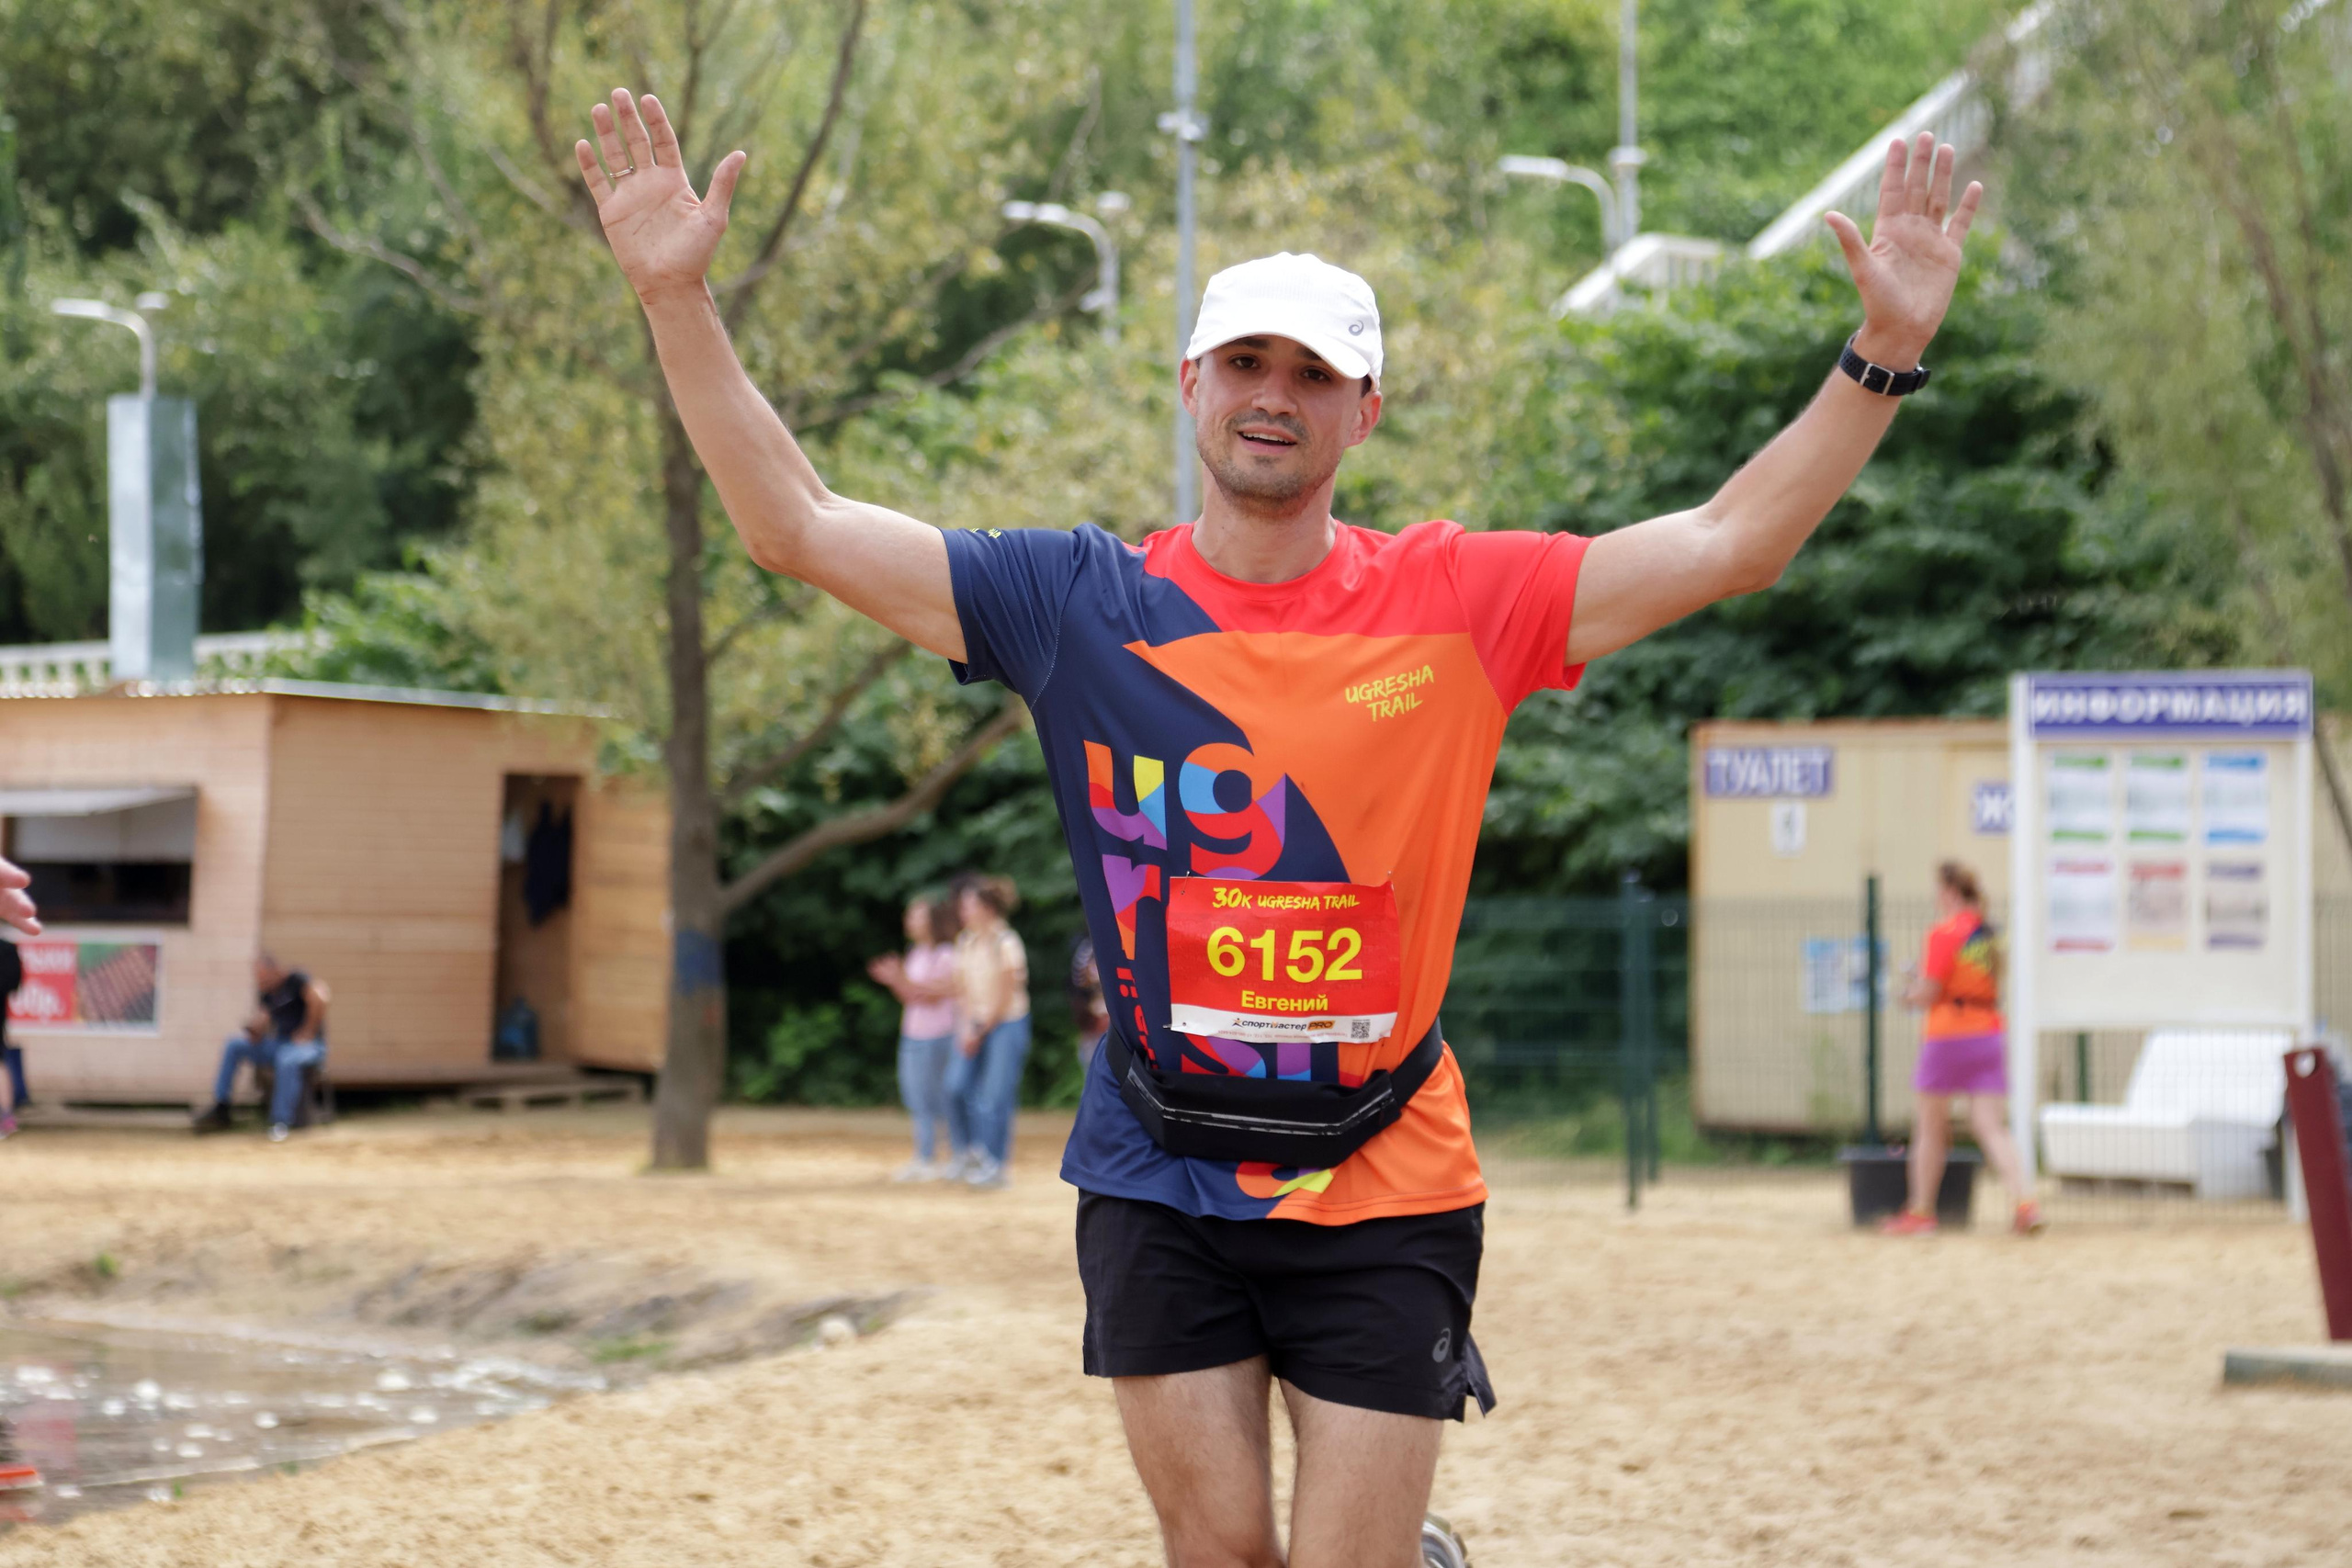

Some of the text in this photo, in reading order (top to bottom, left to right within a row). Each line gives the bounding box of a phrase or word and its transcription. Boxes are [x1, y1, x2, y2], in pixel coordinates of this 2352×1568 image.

[1345, 665, 1434, 704] UGRESHA
[1366, 692, 1424, 722] TRAIL
[2033, 689, 2308, 725] ИНФОРМАЦИЯ
[1707, 748, 1830, 795] ТУАЛЕТ
[1257, 894, 1320, 911] UGRESHA
[1323, 894, 1360, 909] TRAIL
[1206, 926, 1363, 983] 6152
[1241, 990, 1329, 1012] Евгений
[1308, 1021, 1334, 1030] PRO
